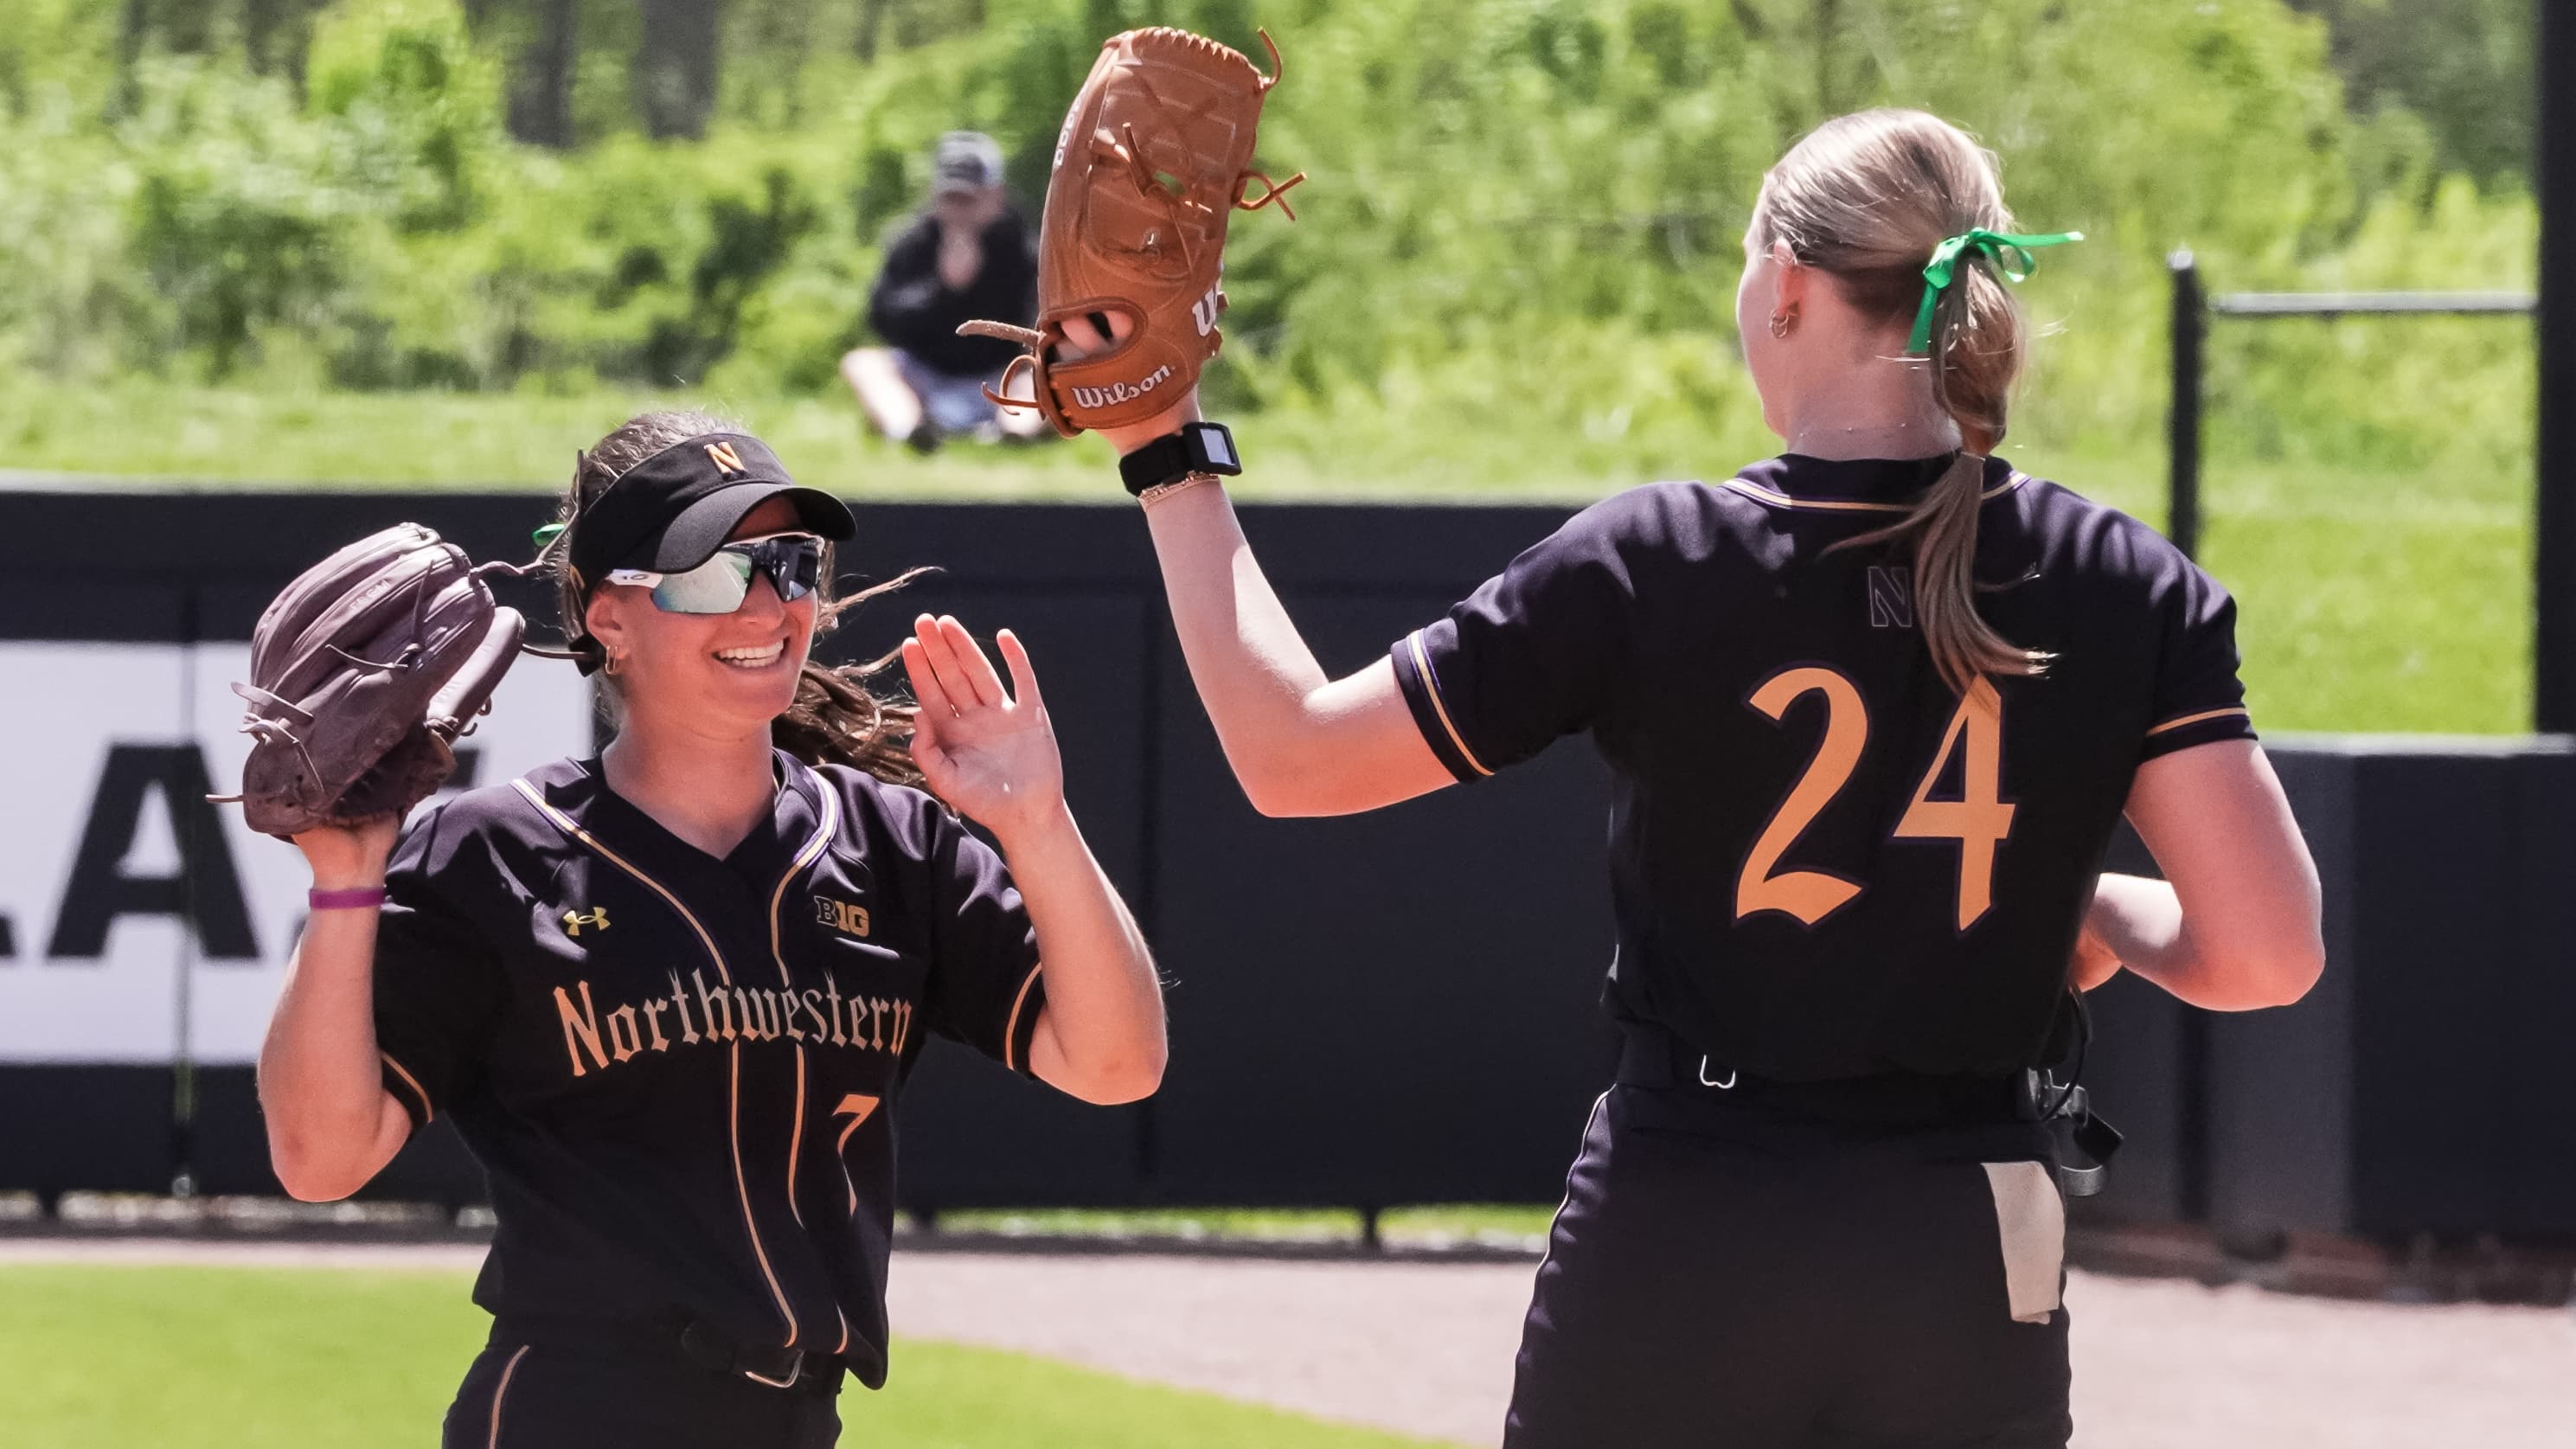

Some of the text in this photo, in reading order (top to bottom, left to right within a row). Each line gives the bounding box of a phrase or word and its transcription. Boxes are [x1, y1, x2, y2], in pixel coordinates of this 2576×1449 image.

[1072, 365, 1171, 408] Wilson
[702, 441, 747, 478] N
[1867, 565, 1913, 627] N
[1732, 664, 2017, 933] 24
[553, 966, 913, 1078] Northwestern
[831, 1093, 880, 1217] 7
